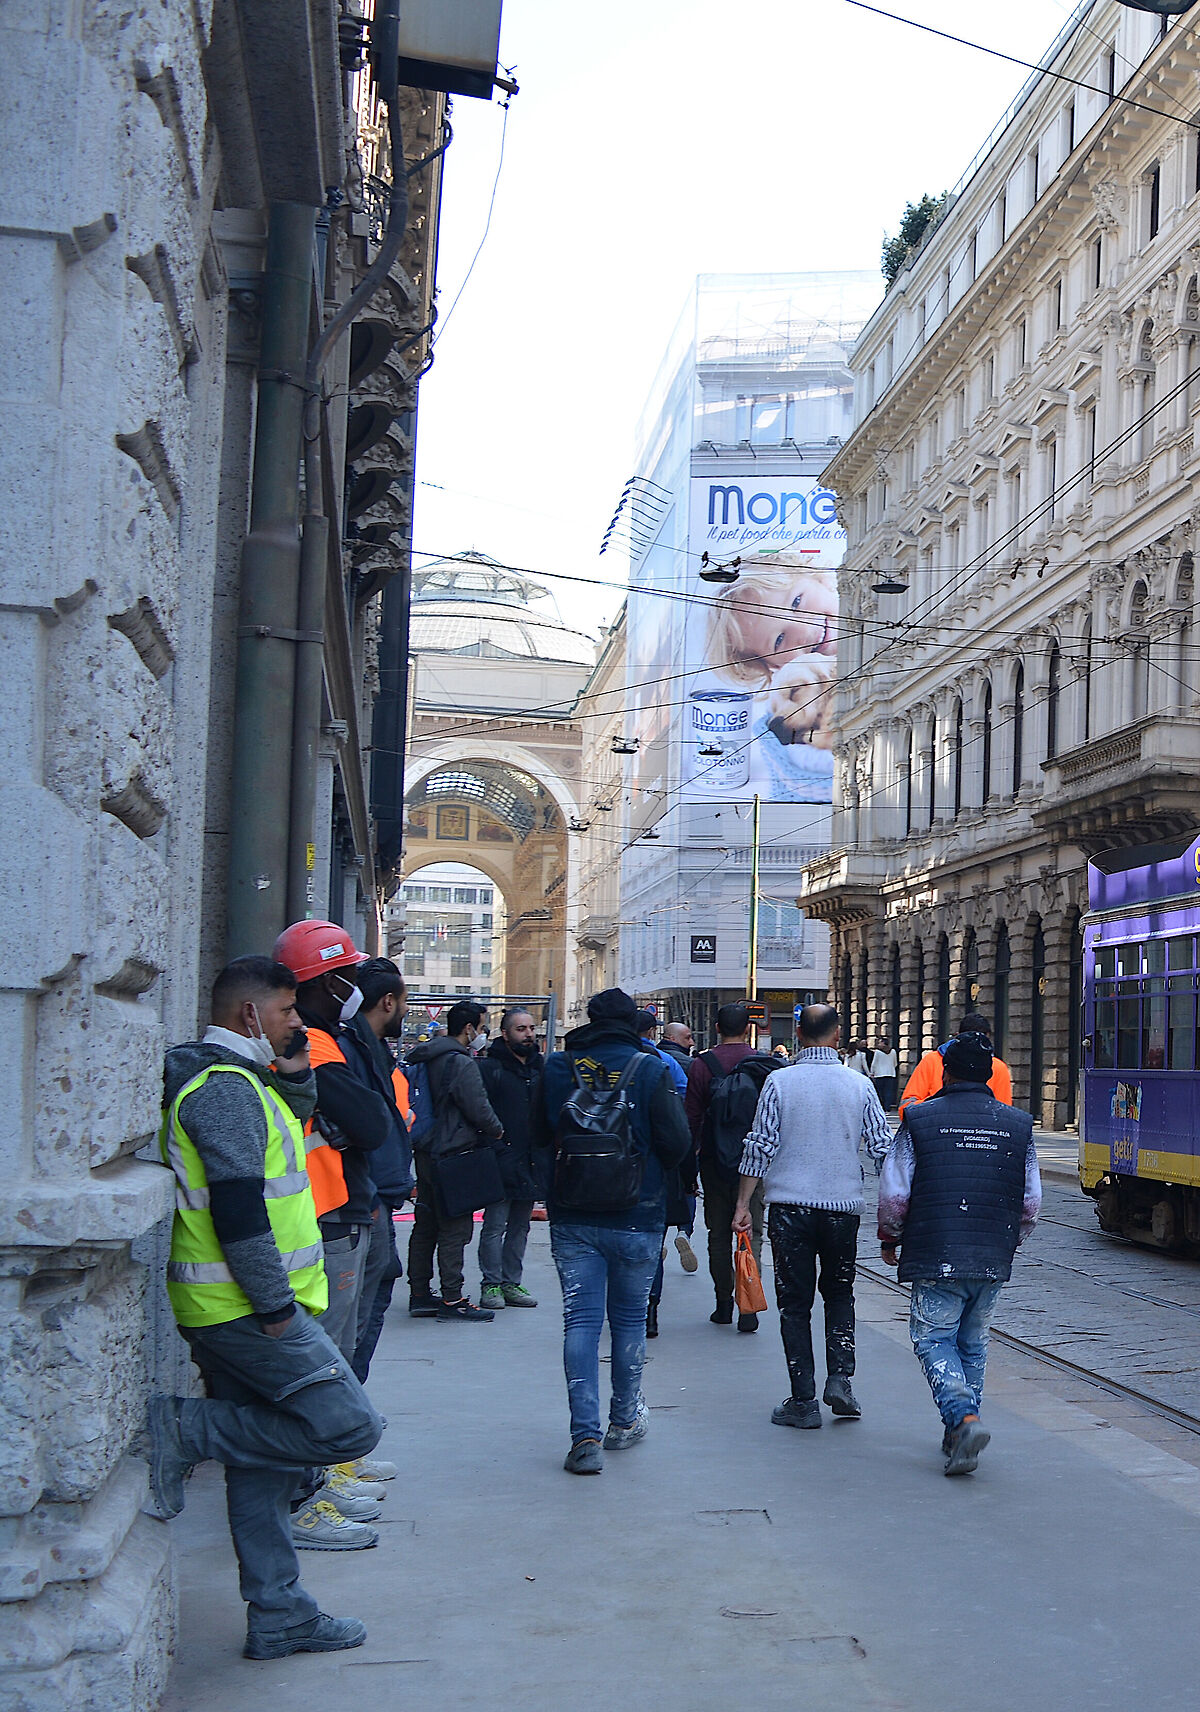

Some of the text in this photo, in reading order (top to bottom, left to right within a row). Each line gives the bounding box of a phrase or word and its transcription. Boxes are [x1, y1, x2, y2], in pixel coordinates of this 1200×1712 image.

[706, 526, 718, 539] Il
[717, 527, 738, 543] pet
[739, 527, 771, 545] food
[771, 527, 792, 540] che
[793, 526, 831, 543] parla
[1113, 1135, 1133, 1164] getir
